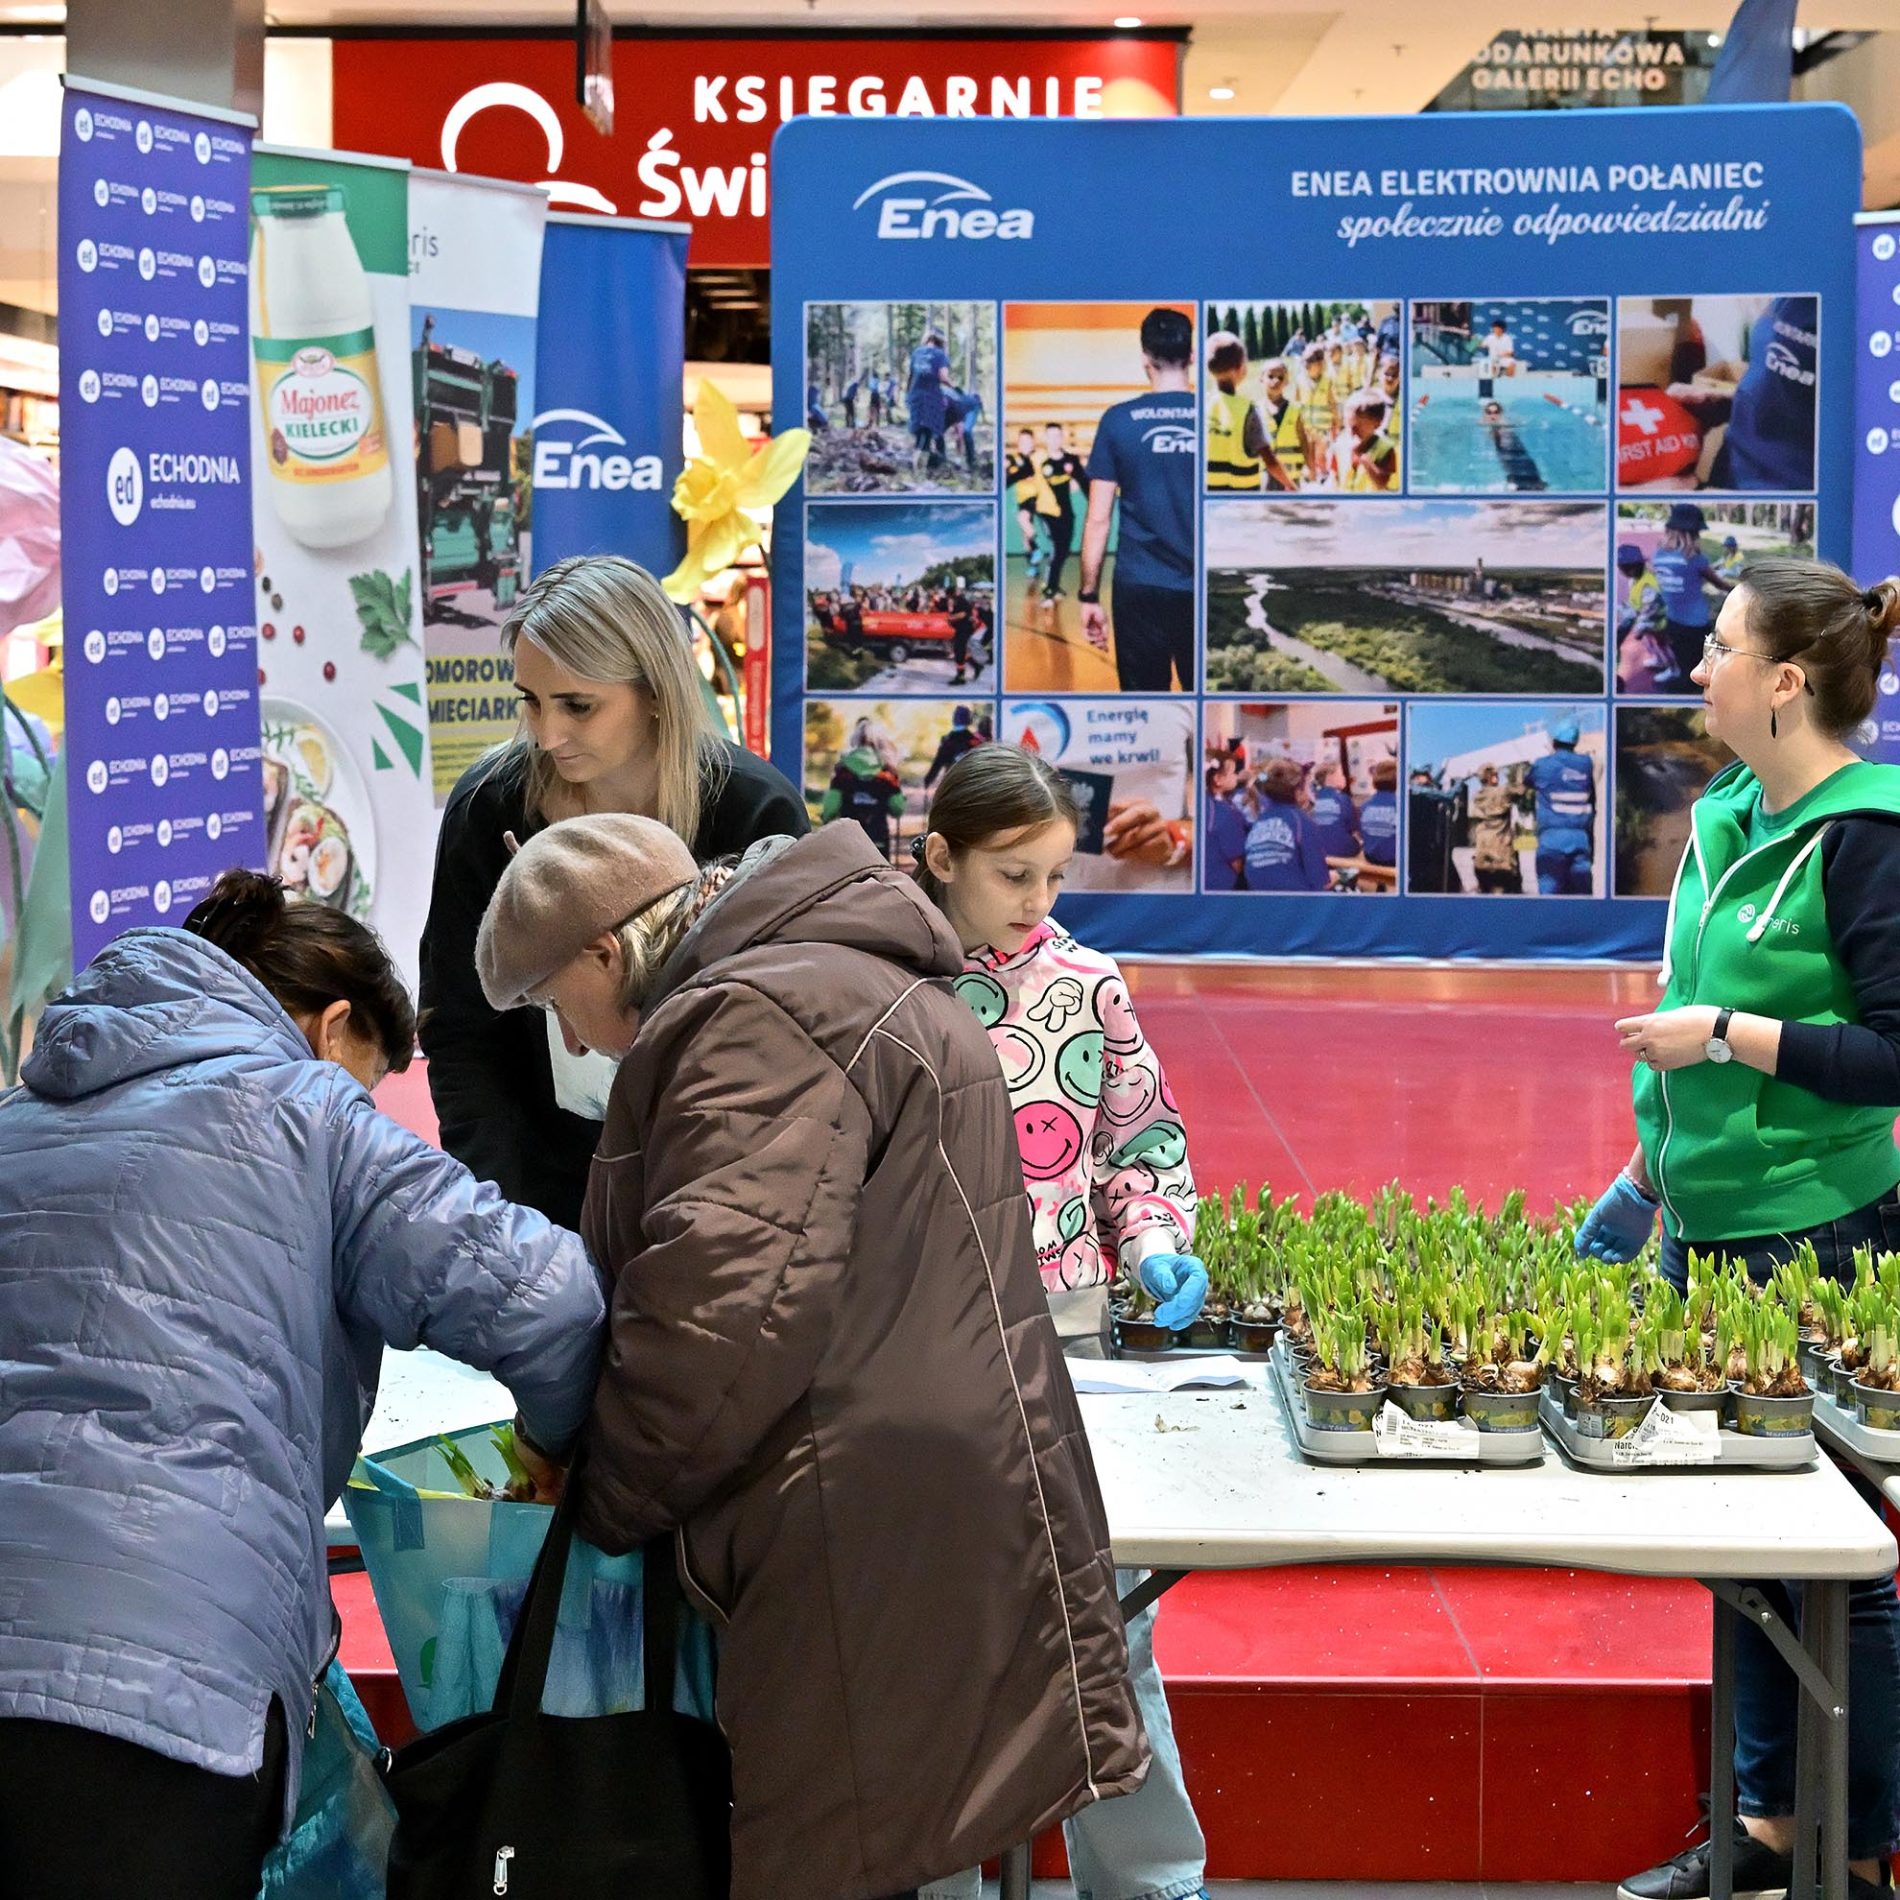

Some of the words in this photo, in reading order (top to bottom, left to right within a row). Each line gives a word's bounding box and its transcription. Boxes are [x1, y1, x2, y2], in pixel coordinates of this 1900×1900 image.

[1471, 67, 1581, 91] GALERII
[1586, 67, 1667, 91] ECHO
[637, 127, 767, 217] Świ
[1291, 171, 1373, 197] ENEA
[1380, 166, 1600, 197] ELEKTROWNIA
[1608, 161, 1764, 192] POŁANIEC
[877, 198, 1035, 239] Enea
[1336, 201, 1502, 248] społecznie
[1512, 194, 1771, 245] odpowiedzialni
[408, 226, 439, 257] ris
[281, 389, 361, 420] Majonez
[285, 418, 358, 438] KIELECKI
[115, 465, 134, 505] ed
[149, 453, 241, 484] ECHODNIA
[531, 440, 663, 491] Enea
[1088, 731, 1137, 745] mamy
[1089, 753, 1113, 765] we
[1756, 915, 1800, 935] eris
